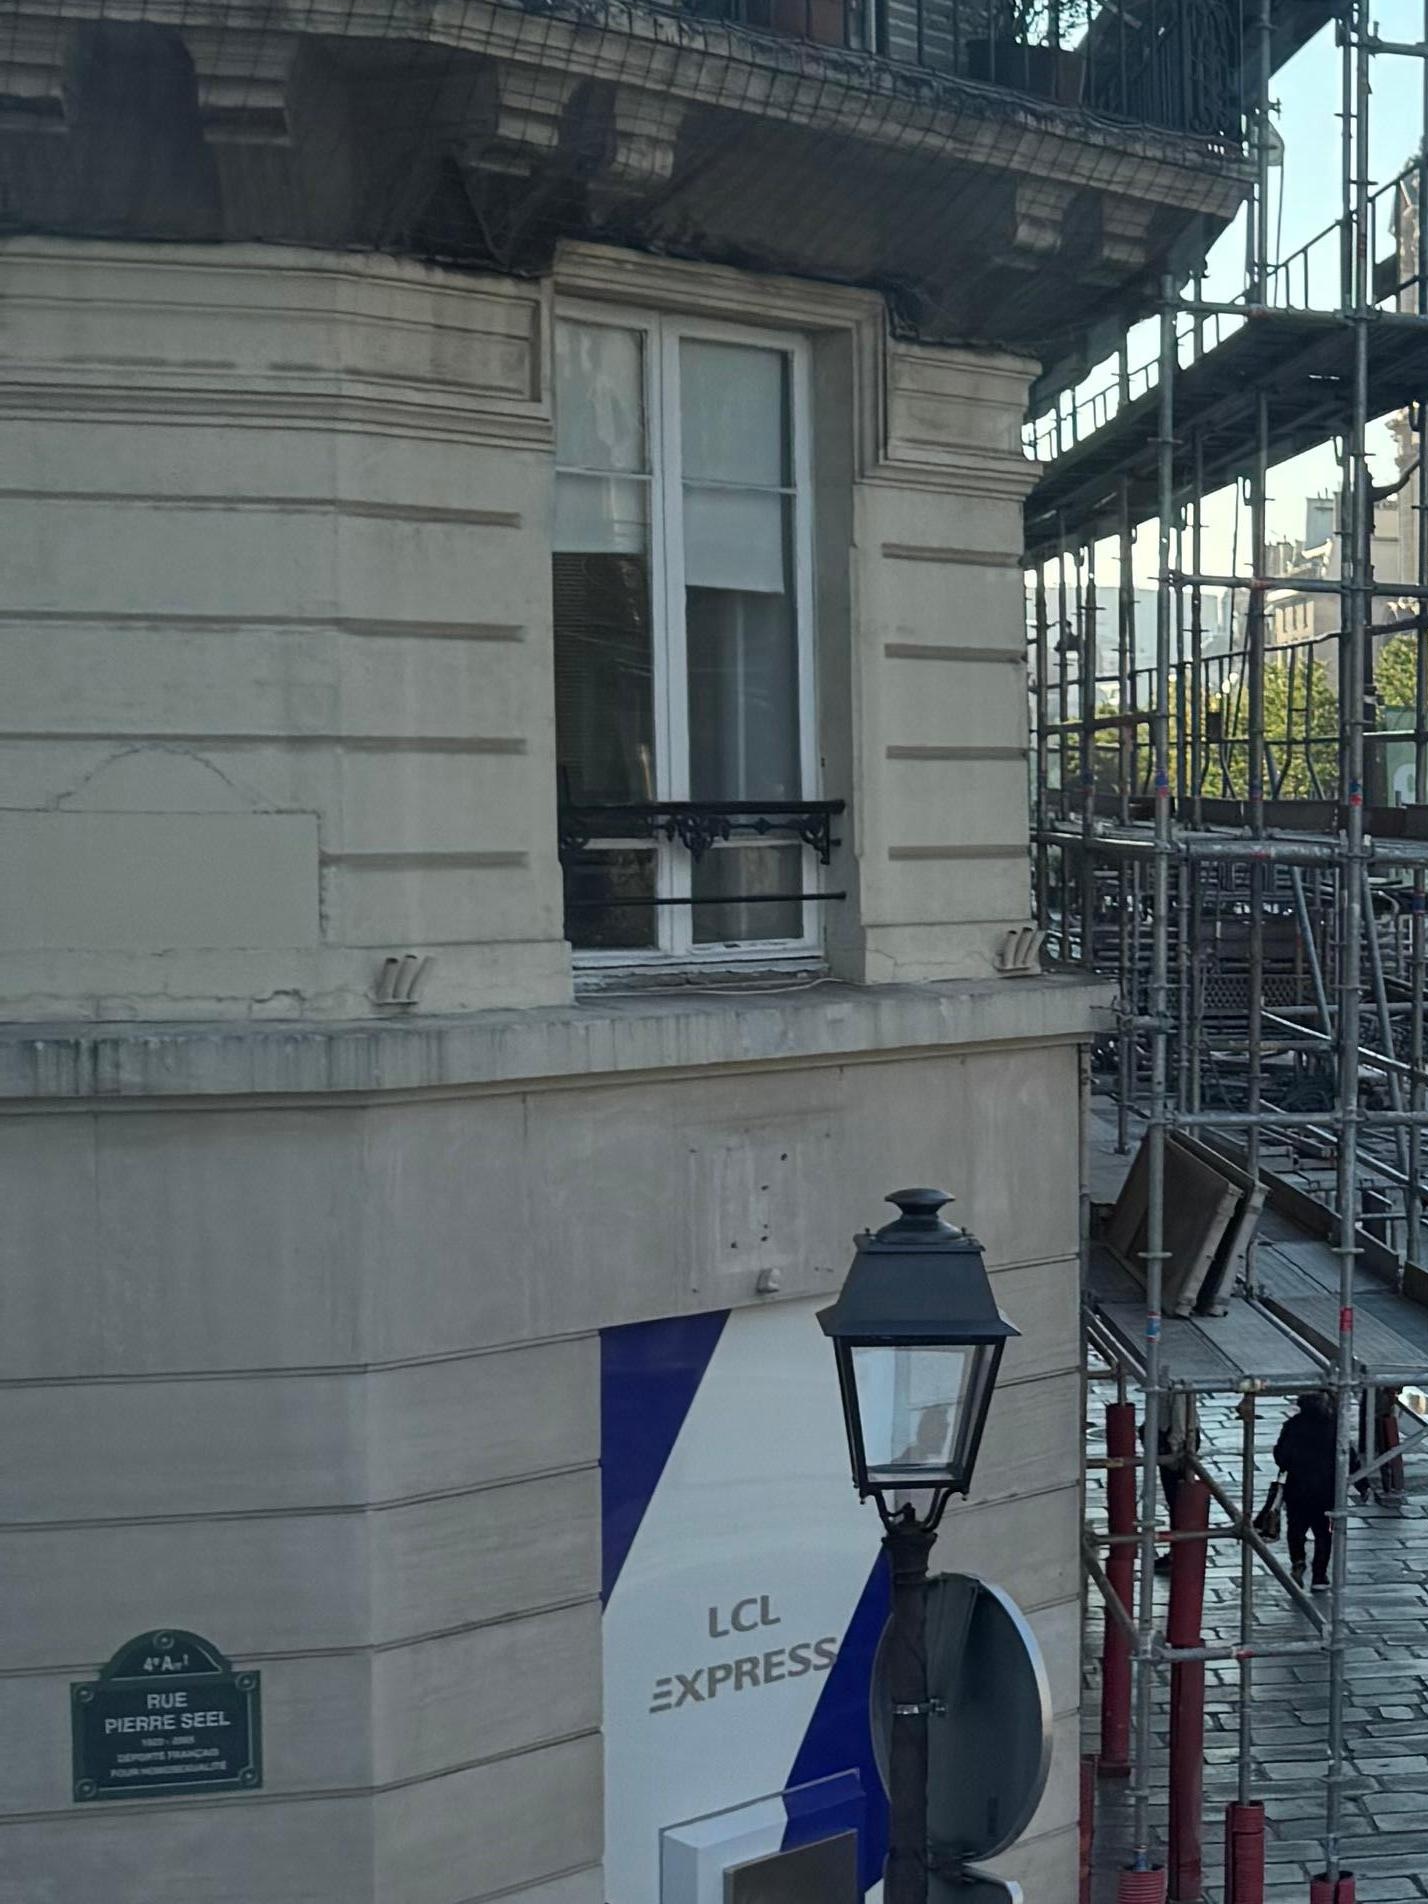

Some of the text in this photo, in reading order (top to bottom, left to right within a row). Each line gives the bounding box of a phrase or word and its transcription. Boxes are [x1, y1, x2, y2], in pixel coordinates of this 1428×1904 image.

[708, 1595, 781, 1639] LCL
[649, 1637, 838, 1714] EXPRESS
[147, 1692, 188, 1709] RUE
[105, 1711, 231, 1734] PIERRE SEEL
